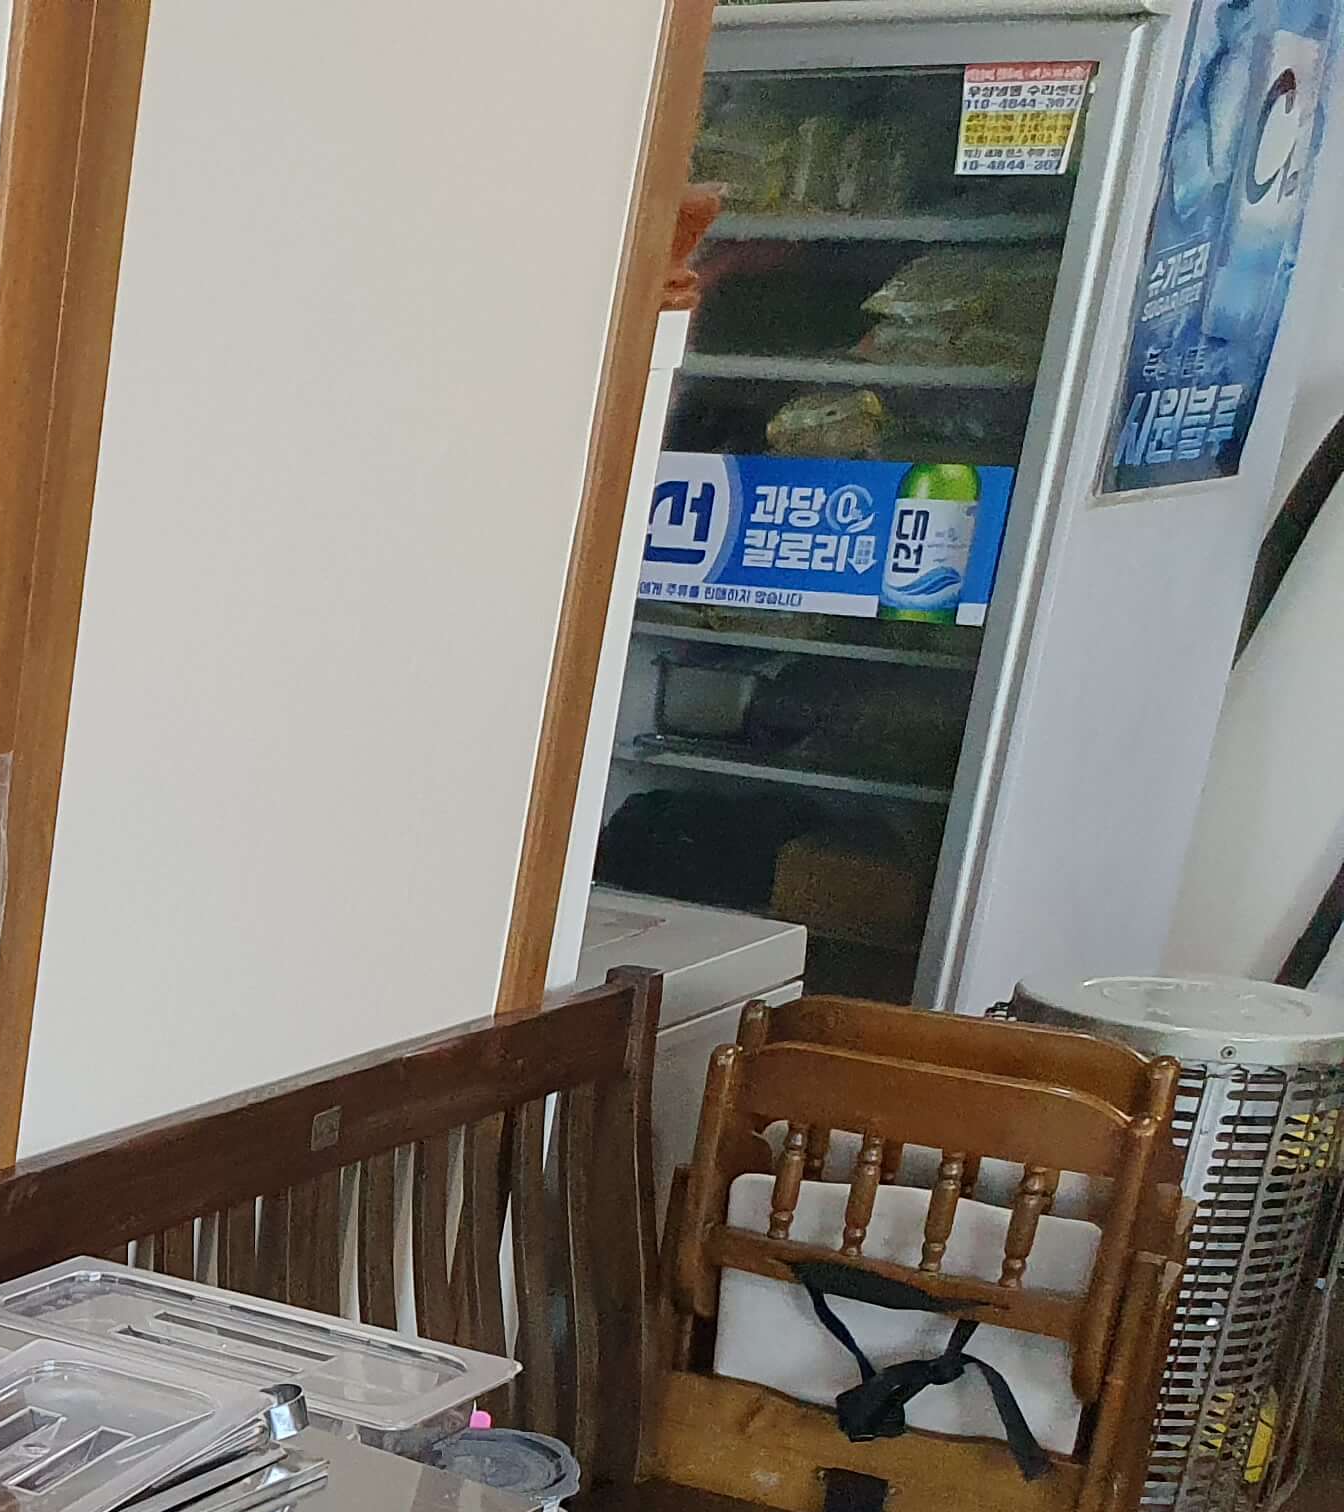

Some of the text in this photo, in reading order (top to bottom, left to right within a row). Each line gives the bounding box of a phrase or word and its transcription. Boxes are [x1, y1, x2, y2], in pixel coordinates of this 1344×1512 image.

[750, 485, 827, 526] 과당
[742, 530, 852, 573] 칼로리
[892, 509, 930, 573] 대선
[705, 586, 750, 604] 판매하지
[755, 591, 803, 607] 않습니다
